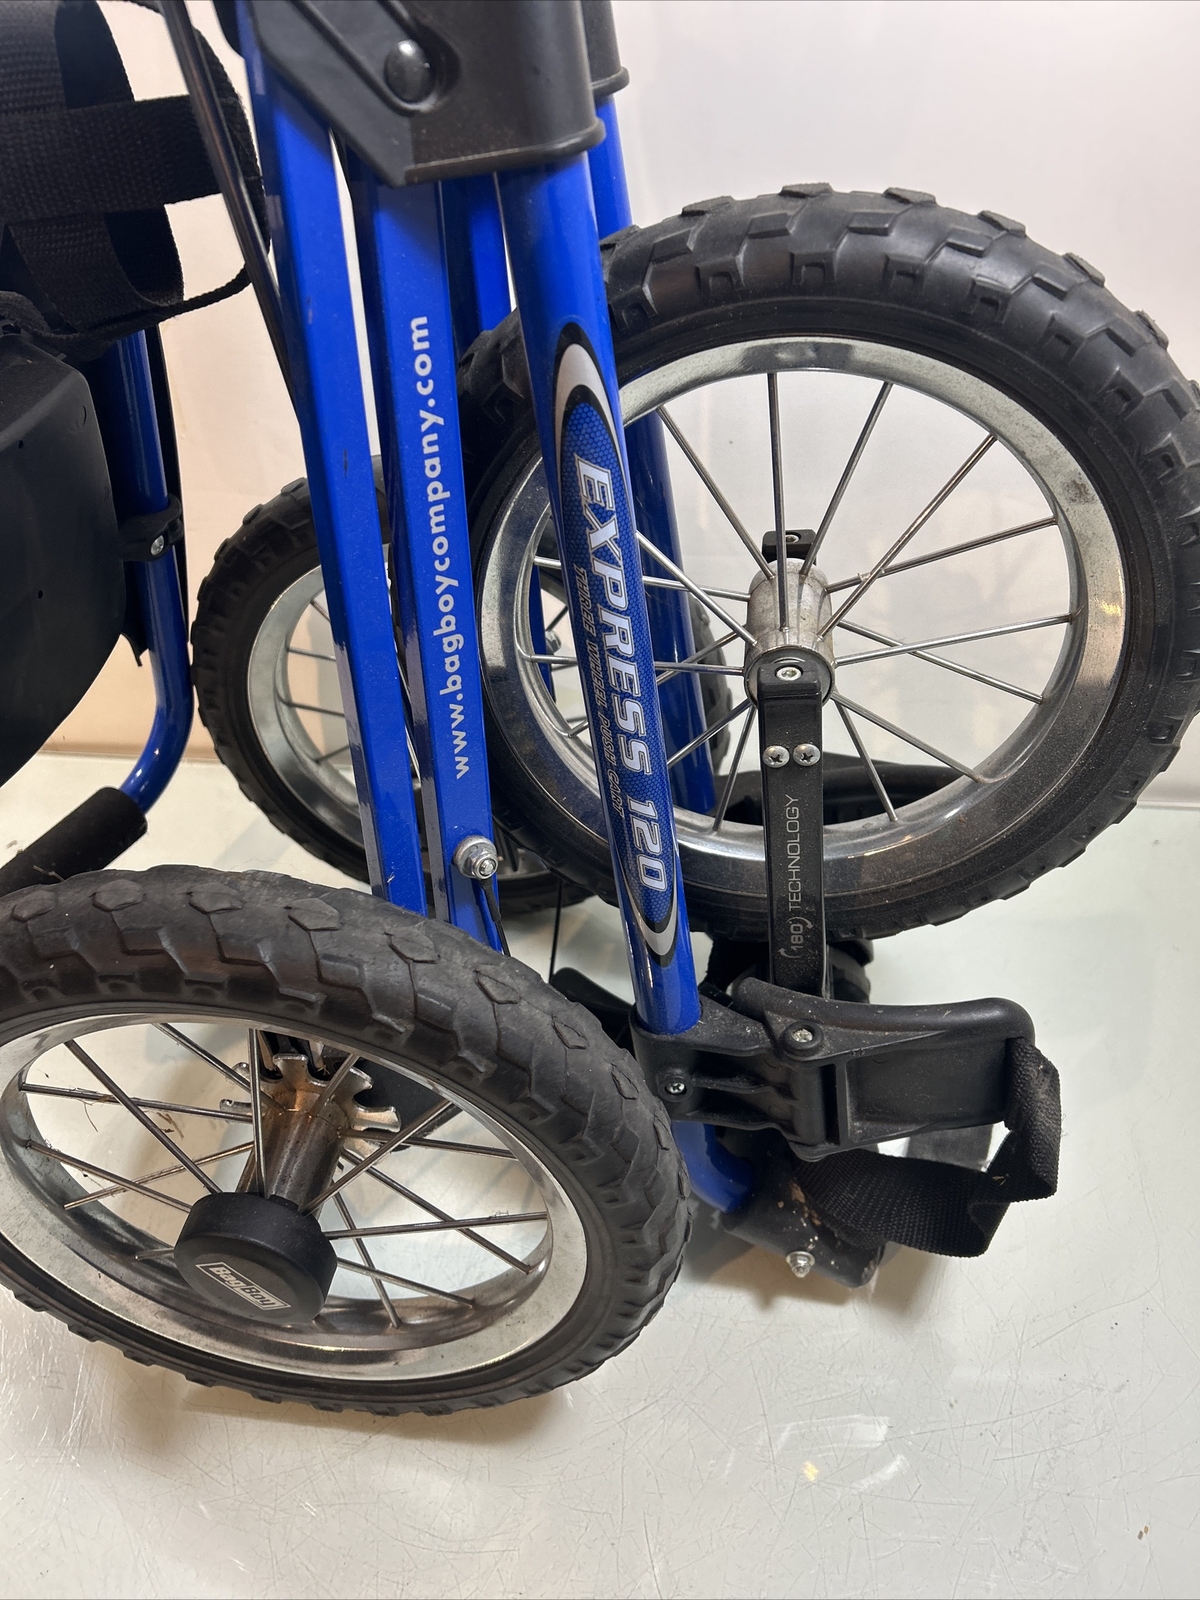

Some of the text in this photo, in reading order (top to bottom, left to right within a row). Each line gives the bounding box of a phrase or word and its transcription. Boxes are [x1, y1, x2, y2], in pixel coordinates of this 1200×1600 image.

[410, 316, 469, 780] www.bagboycompany.com
[574, 453, 668, 891] EXPRESS 120
[574, 563, 625, 818] THREE WHEEL PUSH CART
[785, 794, 802, 912] TECHNOLOGY
